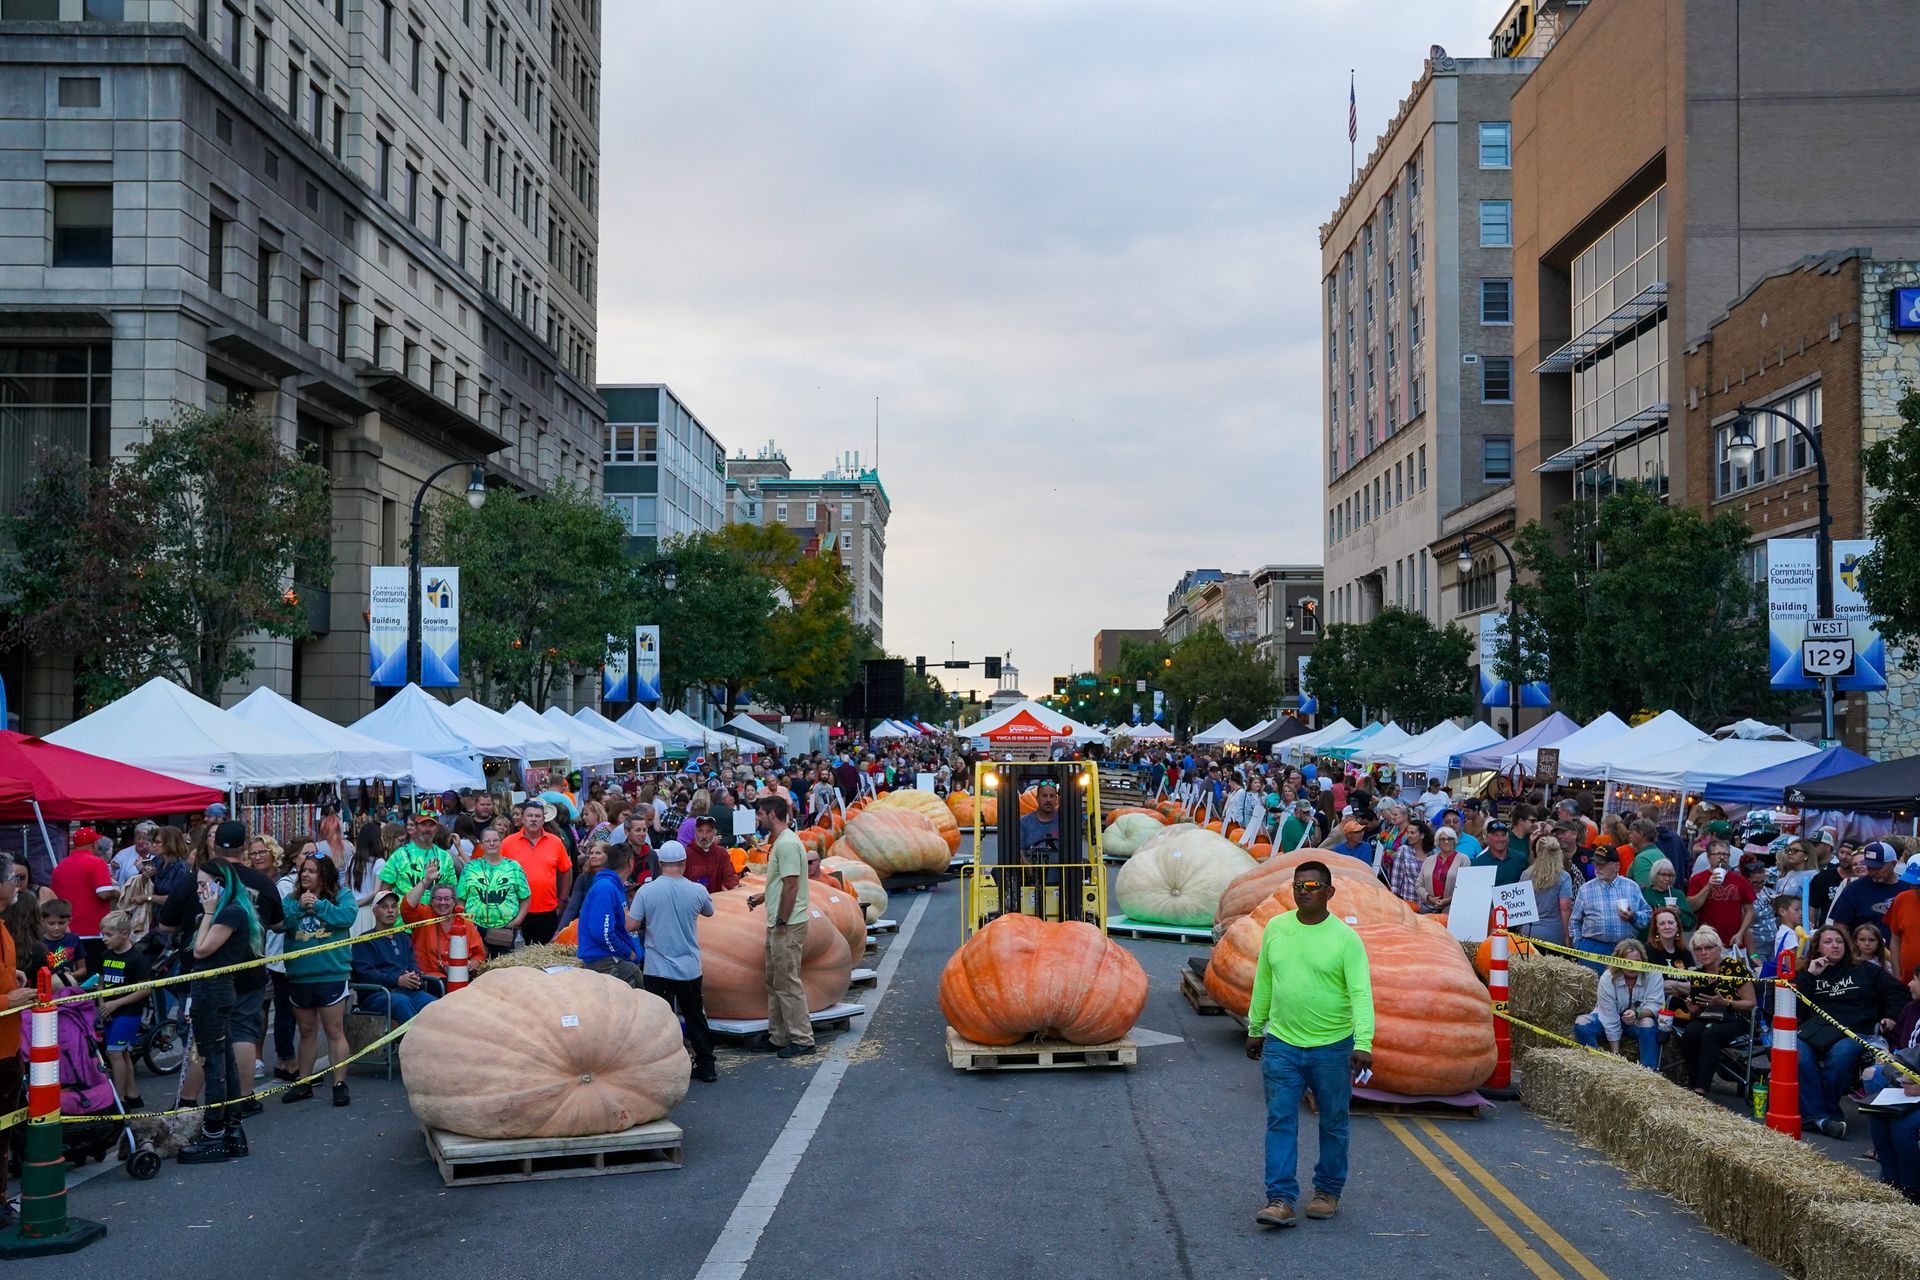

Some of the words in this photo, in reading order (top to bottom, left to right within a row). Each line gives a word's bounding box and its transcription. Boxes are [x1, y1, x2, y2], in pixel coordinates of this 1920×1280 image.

[1770, 567, 1814, 578] Community
[1770, 576, 1813, 585] Foundation
[372, 589, 407, 597] Community
[1770, 602, 1808, 613] Building
[1835, 604, 1870, 614] Growing
[1770, 611, 1815, 620] Community
[372, 625, 406, 633] Community
[423, 625, 457, 633] Philanthropy
[1812, 622, 1843, 634] WEST
[1808, 649, 1846, 667] 129
[1505, 900, 1526, 910] TOUCH
[1506, 910, 1532, 920] UMPKINS
